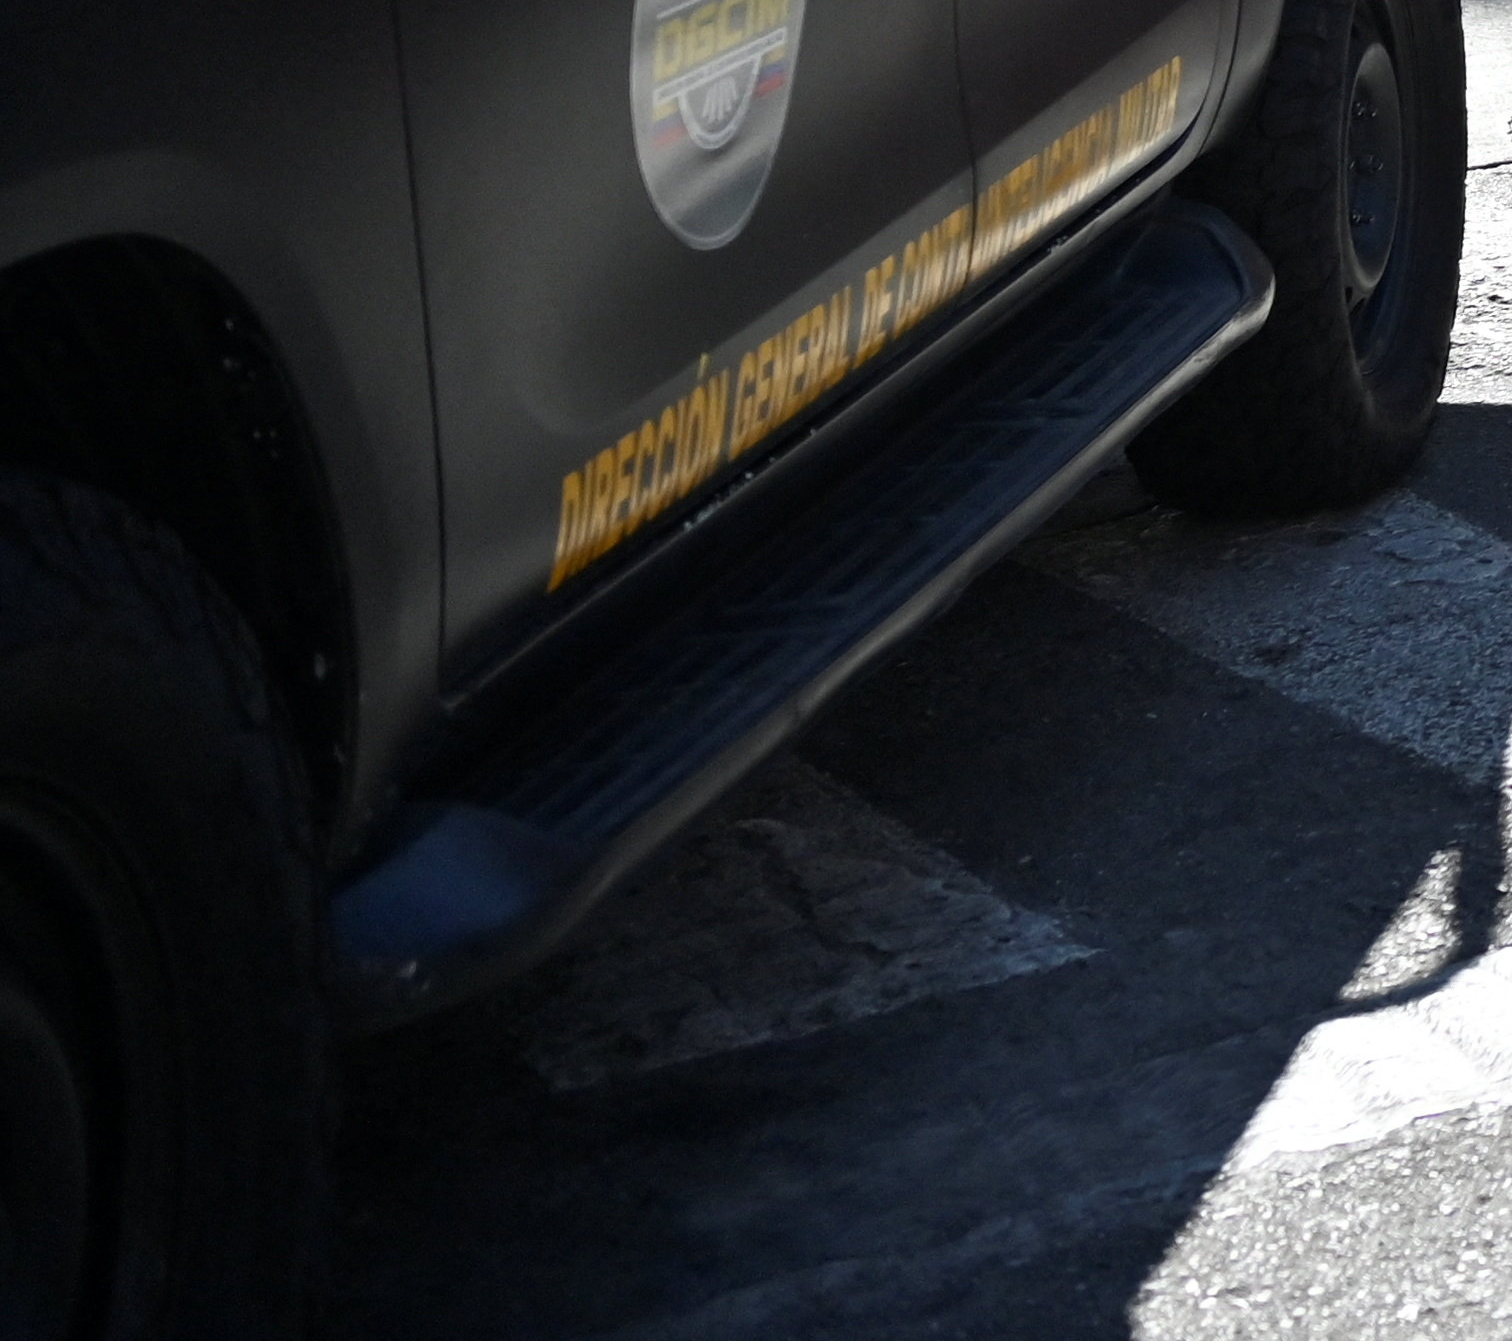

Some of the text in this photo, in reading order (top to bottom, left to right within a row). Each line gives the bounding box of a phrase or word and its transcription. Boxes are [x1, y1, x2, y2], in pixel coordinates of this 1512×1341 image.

[547, 351, 729, 593] DIRECCIÓN
[728, 285, 853, 462] GENERAL
[853, 254, 897, 371] DE
